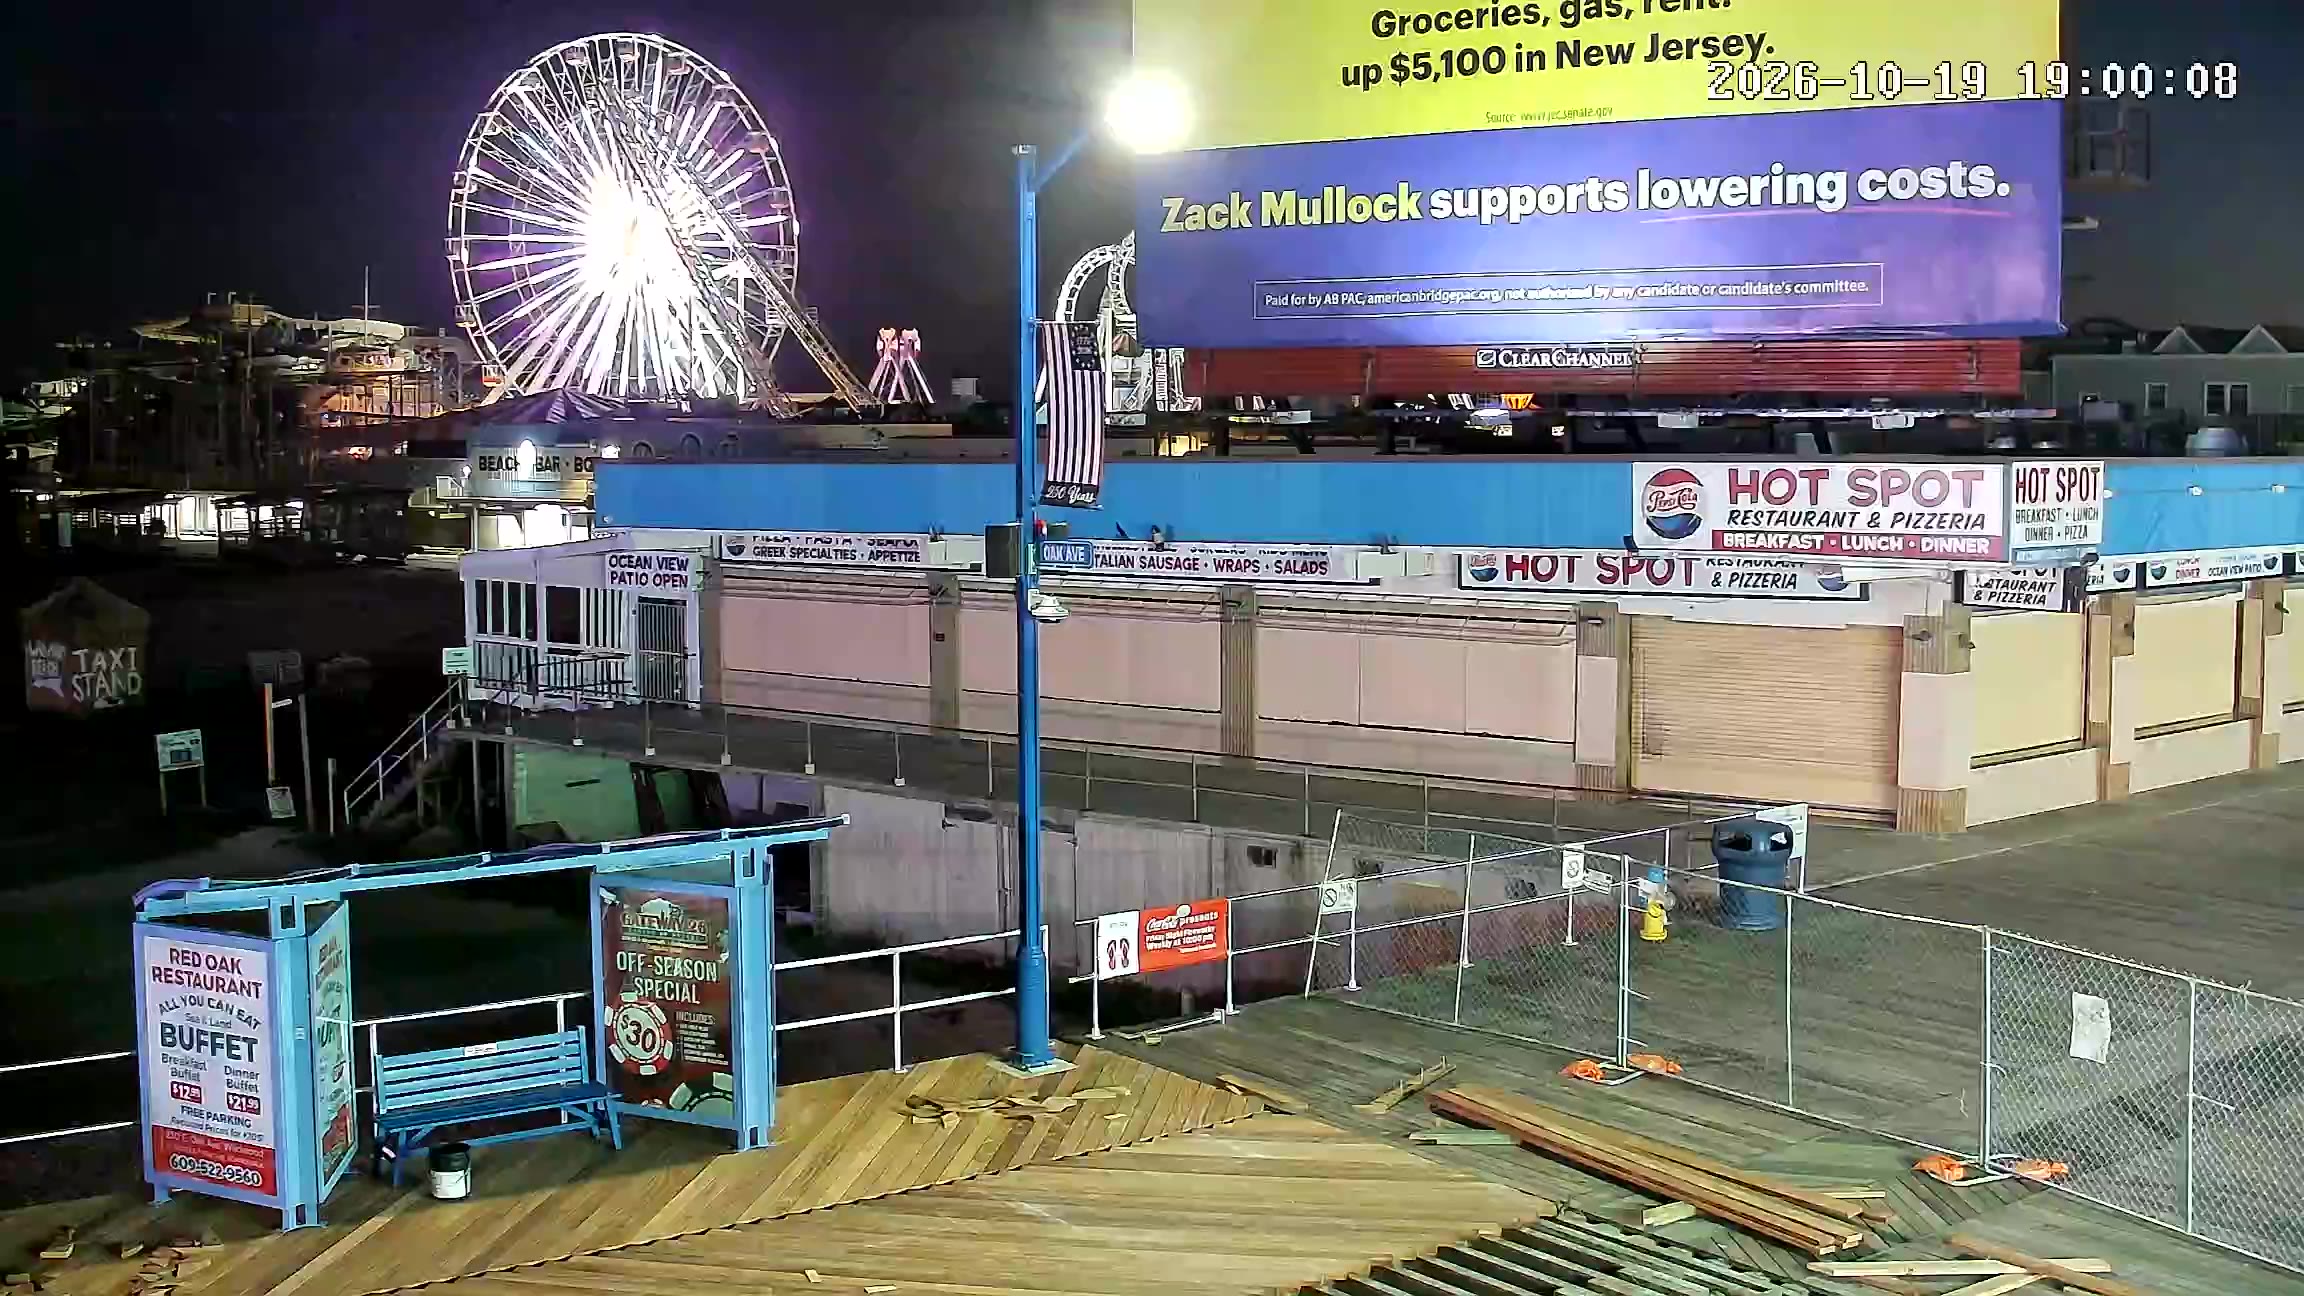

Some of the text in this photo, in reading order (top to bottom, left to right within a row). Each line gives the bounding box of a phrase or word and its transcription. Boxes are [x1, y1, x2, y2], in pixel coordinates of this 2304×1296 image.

[1371, 0, 1550, 39] Groceries,
[1560, 0, 1634, 28] gas,
[1341, 31, 1775, 91] up $5,100 in New Jersey.
[1160, 160, 2011, 233] Zack Mullock supports lowering costs.
[1265, 293, 1288, 306] Paid
[1290, 293, 1306, 306] for
[1308, 293, 1322, 308] by
[1324, 293, 1339, 304] AB
[535, 455, 561, 472] BAR
[1046, 485, 1097, 504] 250 Years
[1728, 467, 1985, 508] HOT SPOT
[2015, 466, 2101, 504] HOT SPOT
[1727, 508, 1987, 531] RESTAURANT & PIZZERIA
[2015, 507, 2099, 524] BREAKFAST LUNCH
[1722, 532, 1991, 555] BREAKFAST LUNCH DINNER
[2025, 525, 2088, 542] DINNER PIZZA
[608, 554, 689, 571] OCEAN VIEW
[752, 546, 786, 559] GREEK
[789, 547, 858, 561] SPECIALTIES
[1043, 544, 1064, 561] OAK
[1065, 545, 1085, 561] AVE
[1094, 553, 1329, 576] TALIAN SAUSAGE WRAPS SALADS
[610, 570, 689, 588] PATIO OPEN
[1504, 554, 1583, 584] HOT
[1595, 554, 1698, 588] SPOT
[1711, 571, 1799, 590] & PIZZERIA
[1973, 589, 2047, 606] & PIZZERIA
[72, 647, 137, 672] TAXI
[71, 670, 143, 703] STAND
[169, 948, 243, 975] RED OAK
[616, 951, 719, 982] OFF-SEASON
[151, 965, 262, 999] RESTAURANT
[633, 977, 701, 1004] SPECIAL
[158, 994, 262, 1031] ALL YOU CAN EAT
[160, 1021, 259, 1063] BUFFET
[621, 1013, 657, 1052] $30
[223, 1065, 260, 1081] Dinner
[181, 1105, 252, 1129] FREE PARKING
[169, 1153, 262, 1187] 609-522-9560
